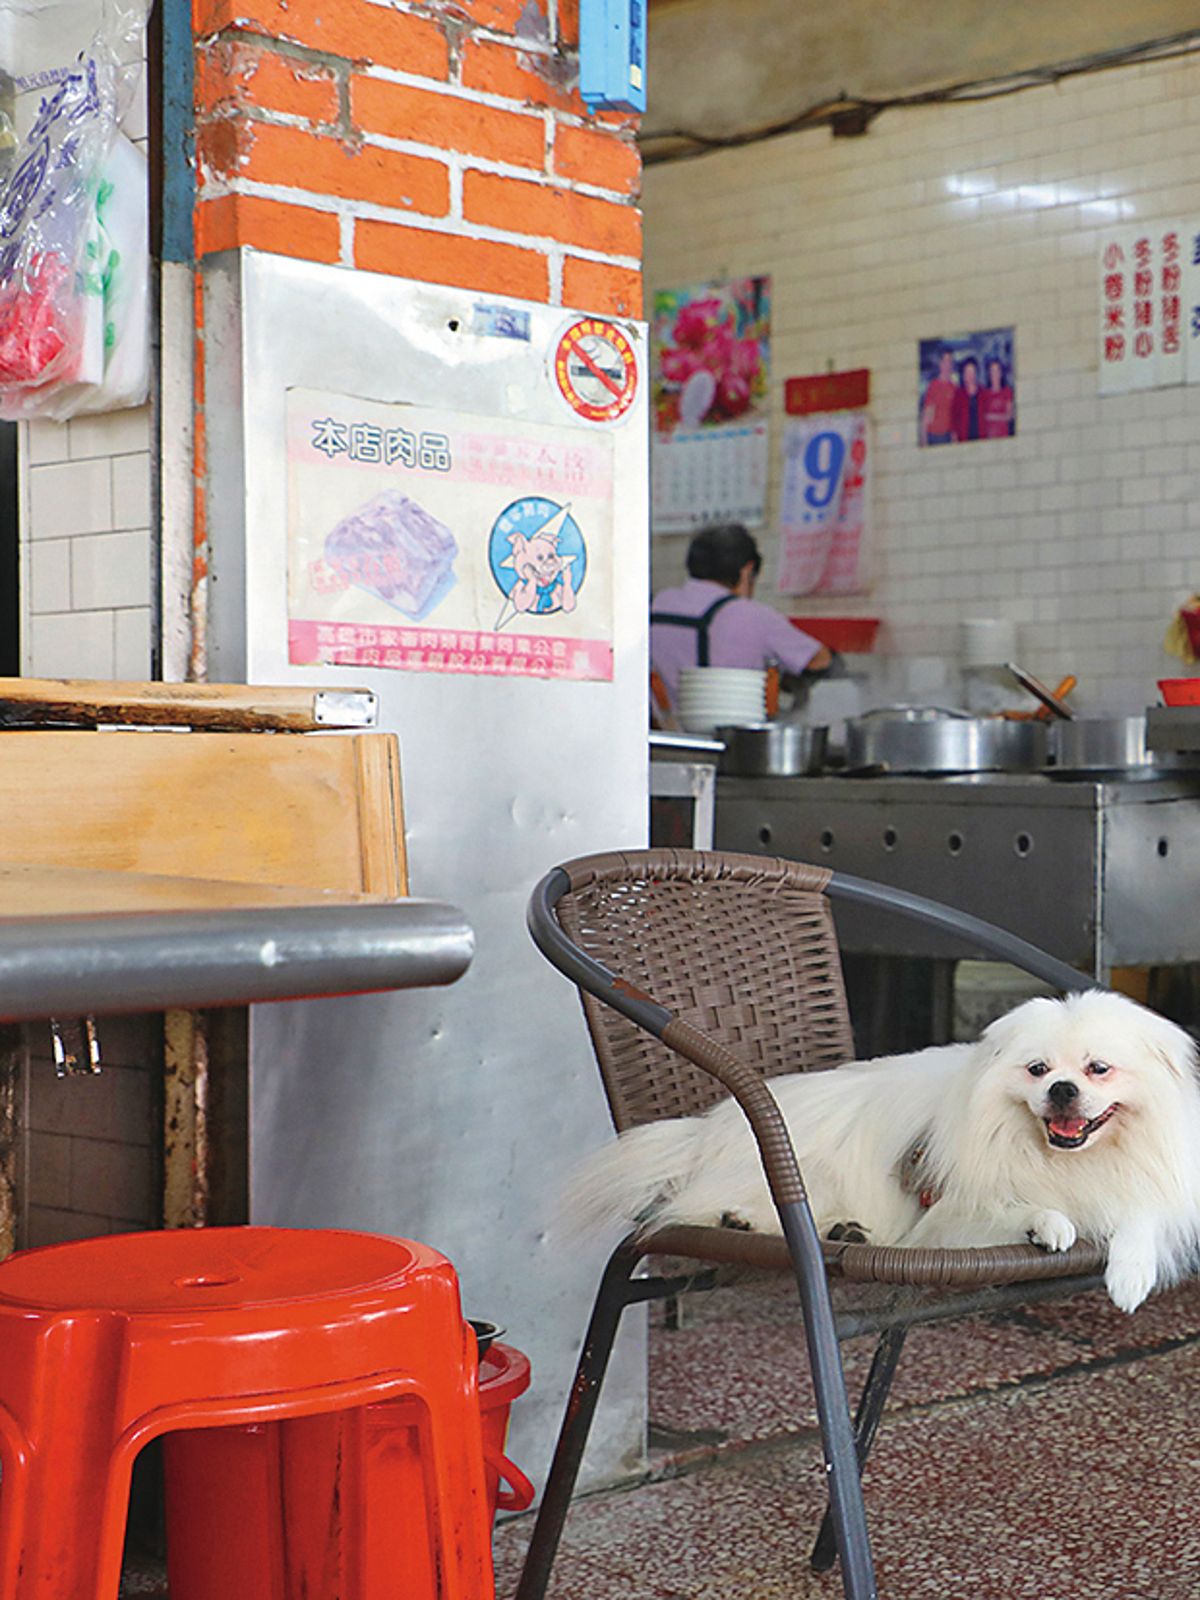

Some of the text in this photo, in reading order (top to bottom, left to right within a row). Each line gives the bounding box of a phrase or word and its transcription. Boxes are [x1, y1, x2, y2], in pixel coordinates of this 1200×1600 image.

[310, 416, 453, 472] 本店肉品
[803, 430, 847, 509] 9
